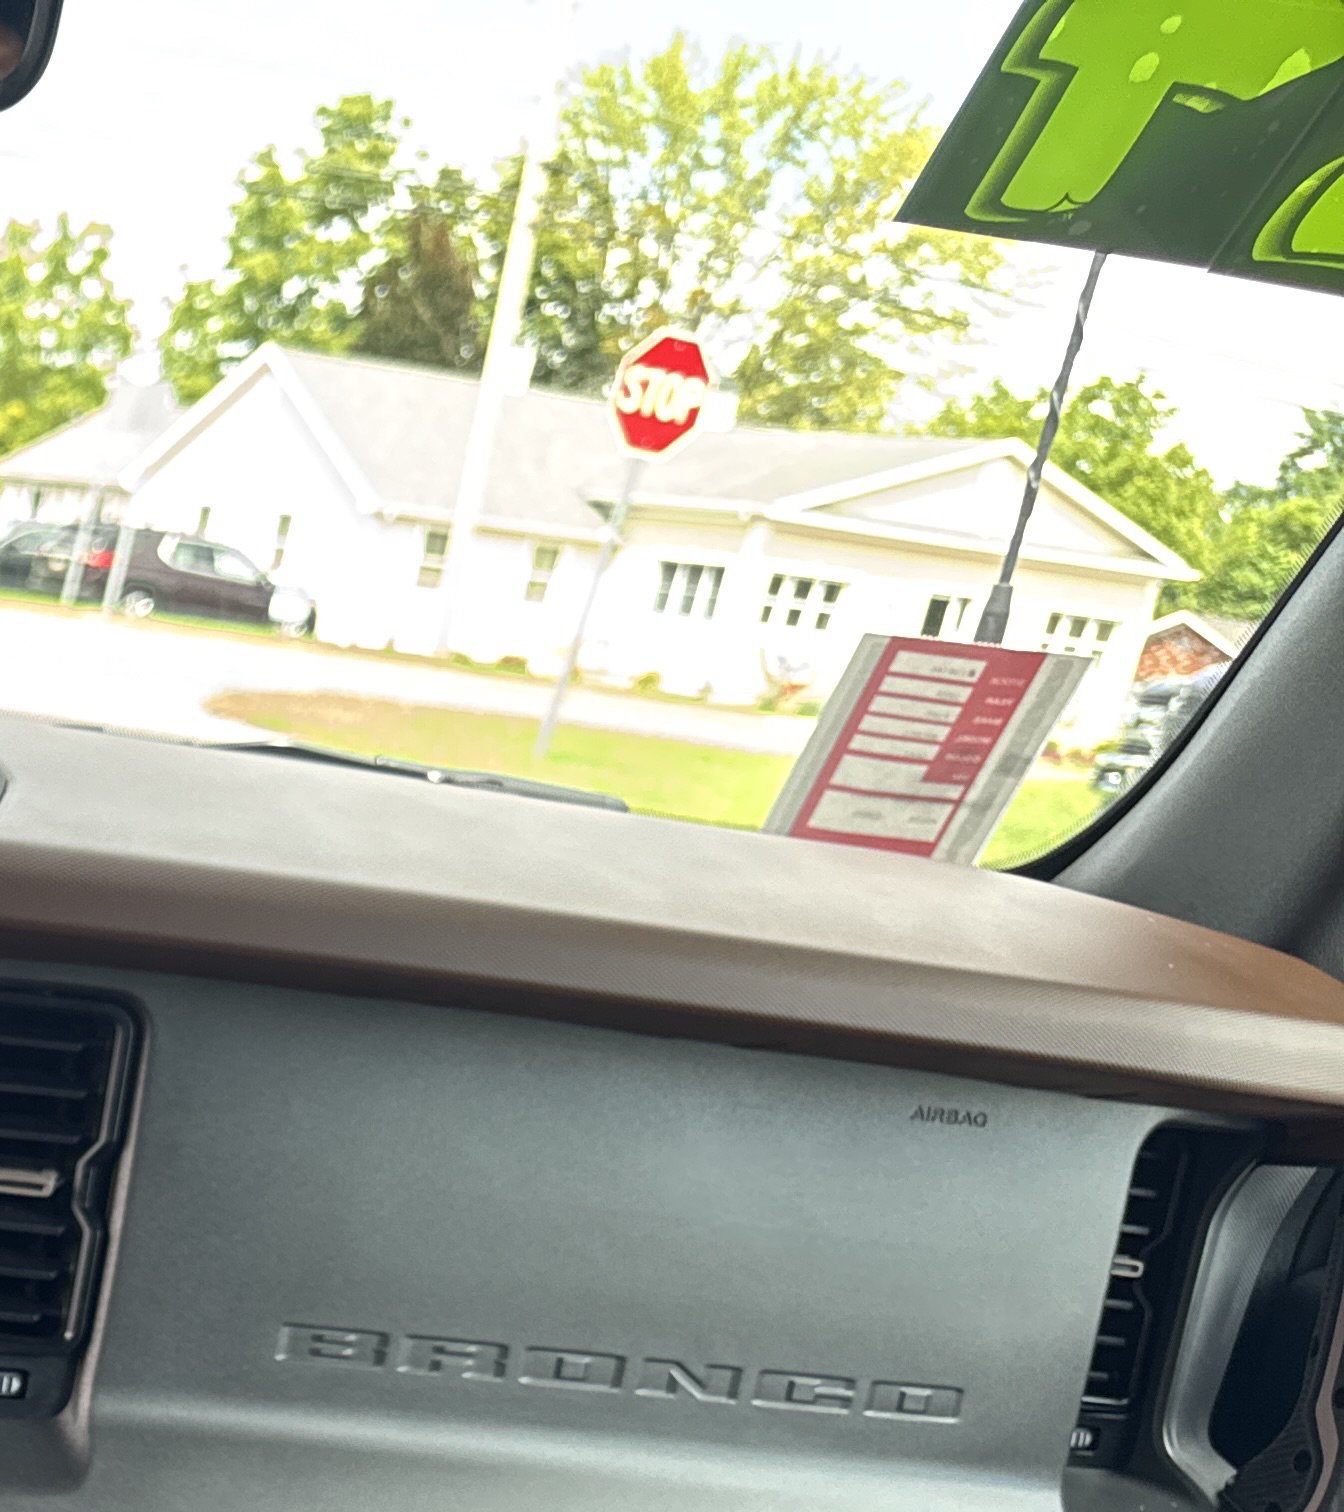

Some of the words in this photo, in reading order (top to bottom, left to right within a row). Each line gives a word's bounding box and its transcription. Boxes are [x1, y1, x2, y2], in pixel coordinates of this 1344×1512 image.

[616, 364, 706, 426] STOP
[910, 1104, 988, 1129] AIRBAG
[274, 1321, 966, 1425] BRONCO
